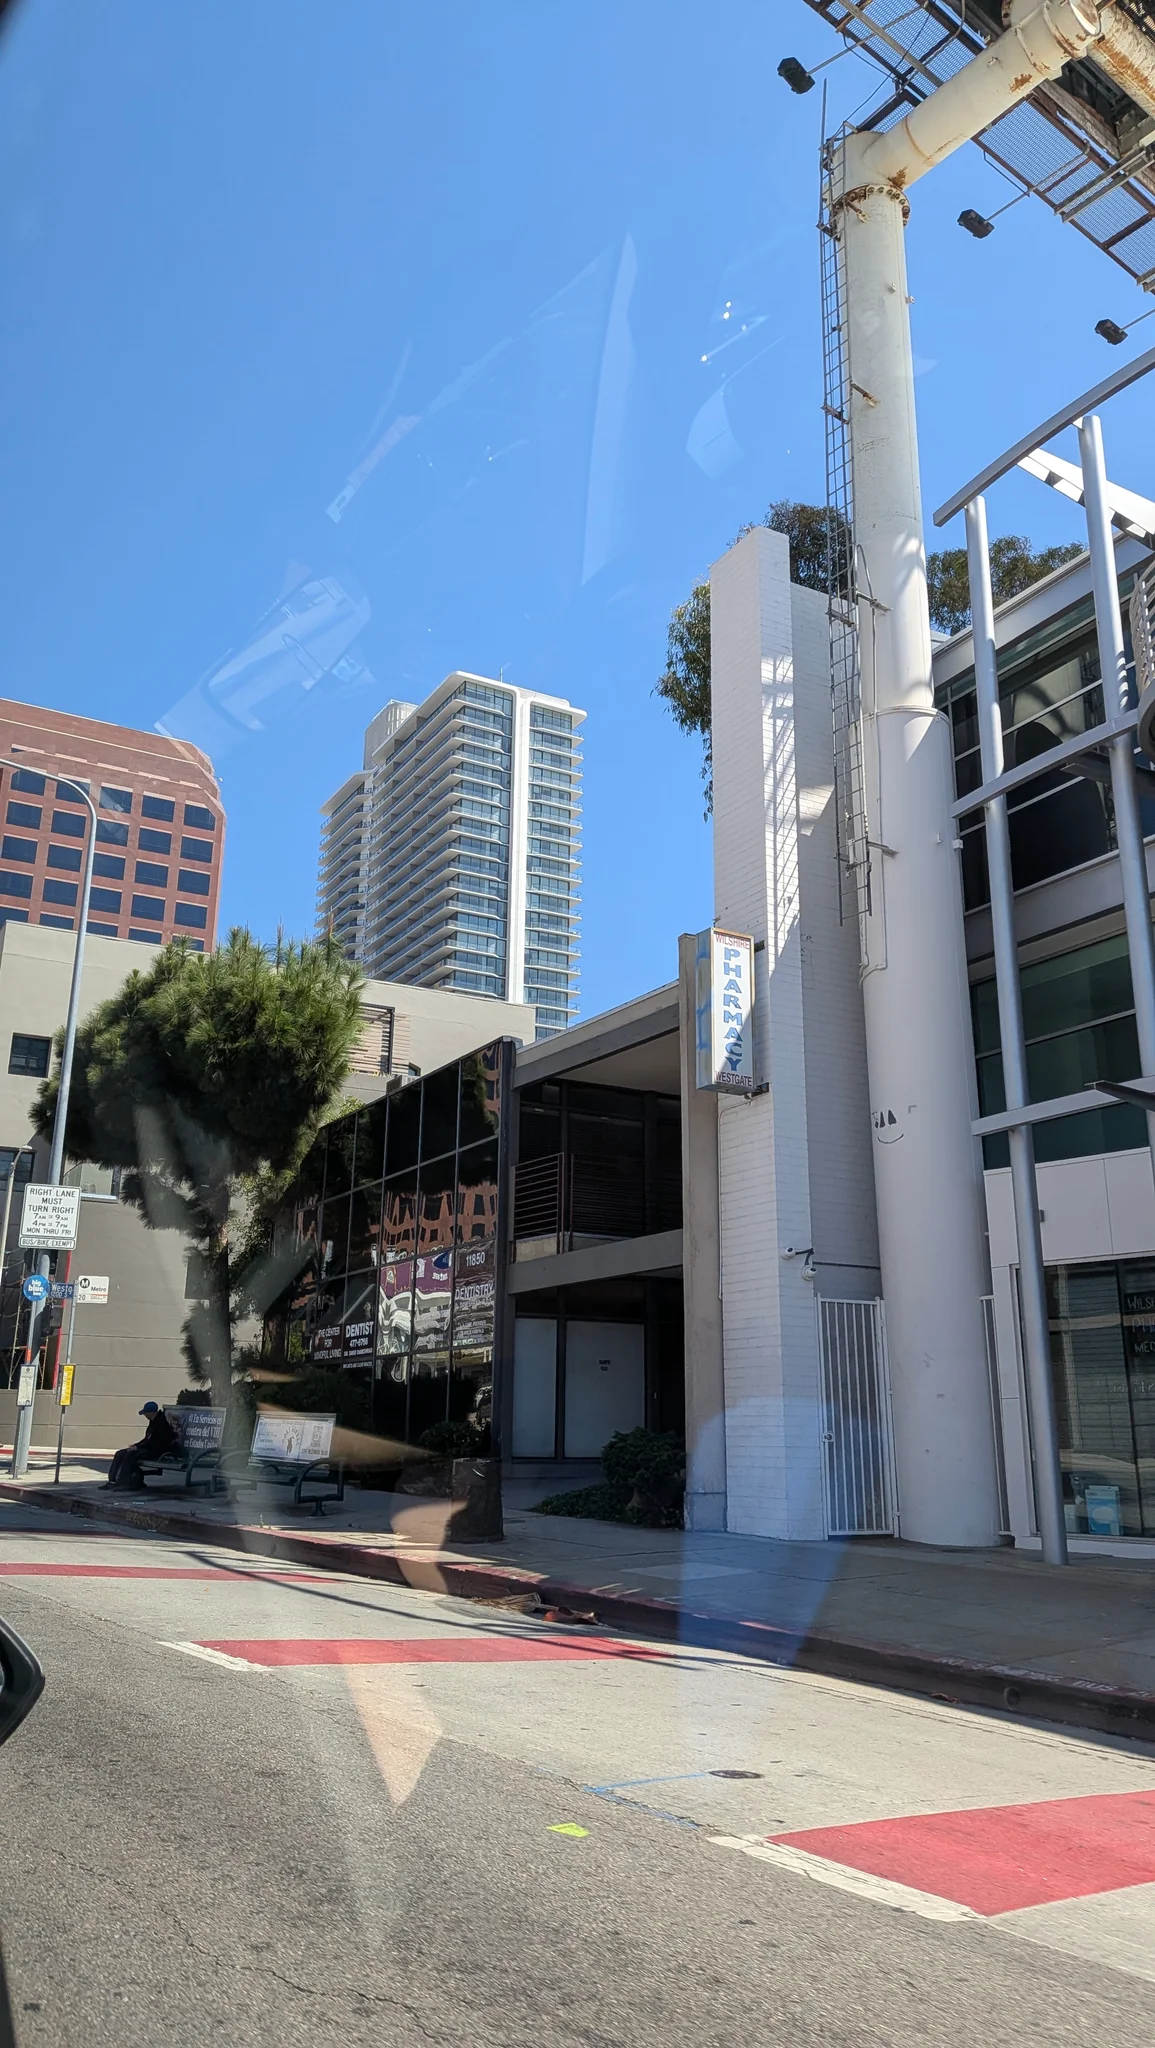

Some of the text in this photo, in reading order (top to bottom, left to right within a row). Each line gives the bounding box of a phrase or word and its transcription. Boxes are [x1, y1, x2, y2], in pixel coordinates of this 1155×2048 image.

[715, 934, 750, 950] WILSHIRE
[723, 947, 743, 1072] PHARMACY
[715, 1071, 752, 1087] WESTGATE
[30, 1188, 76, 1198] RIGHT LANE
[28, 1204, 74, 1214] TURN RIGHT
[466, 1252, 486, 1266] 11850
[455, 1282, 494, 1300] DENTISTRY
[346, 1321, 374, 1338] DENTIST
[330, 1348, 342, 1358] LIVING
